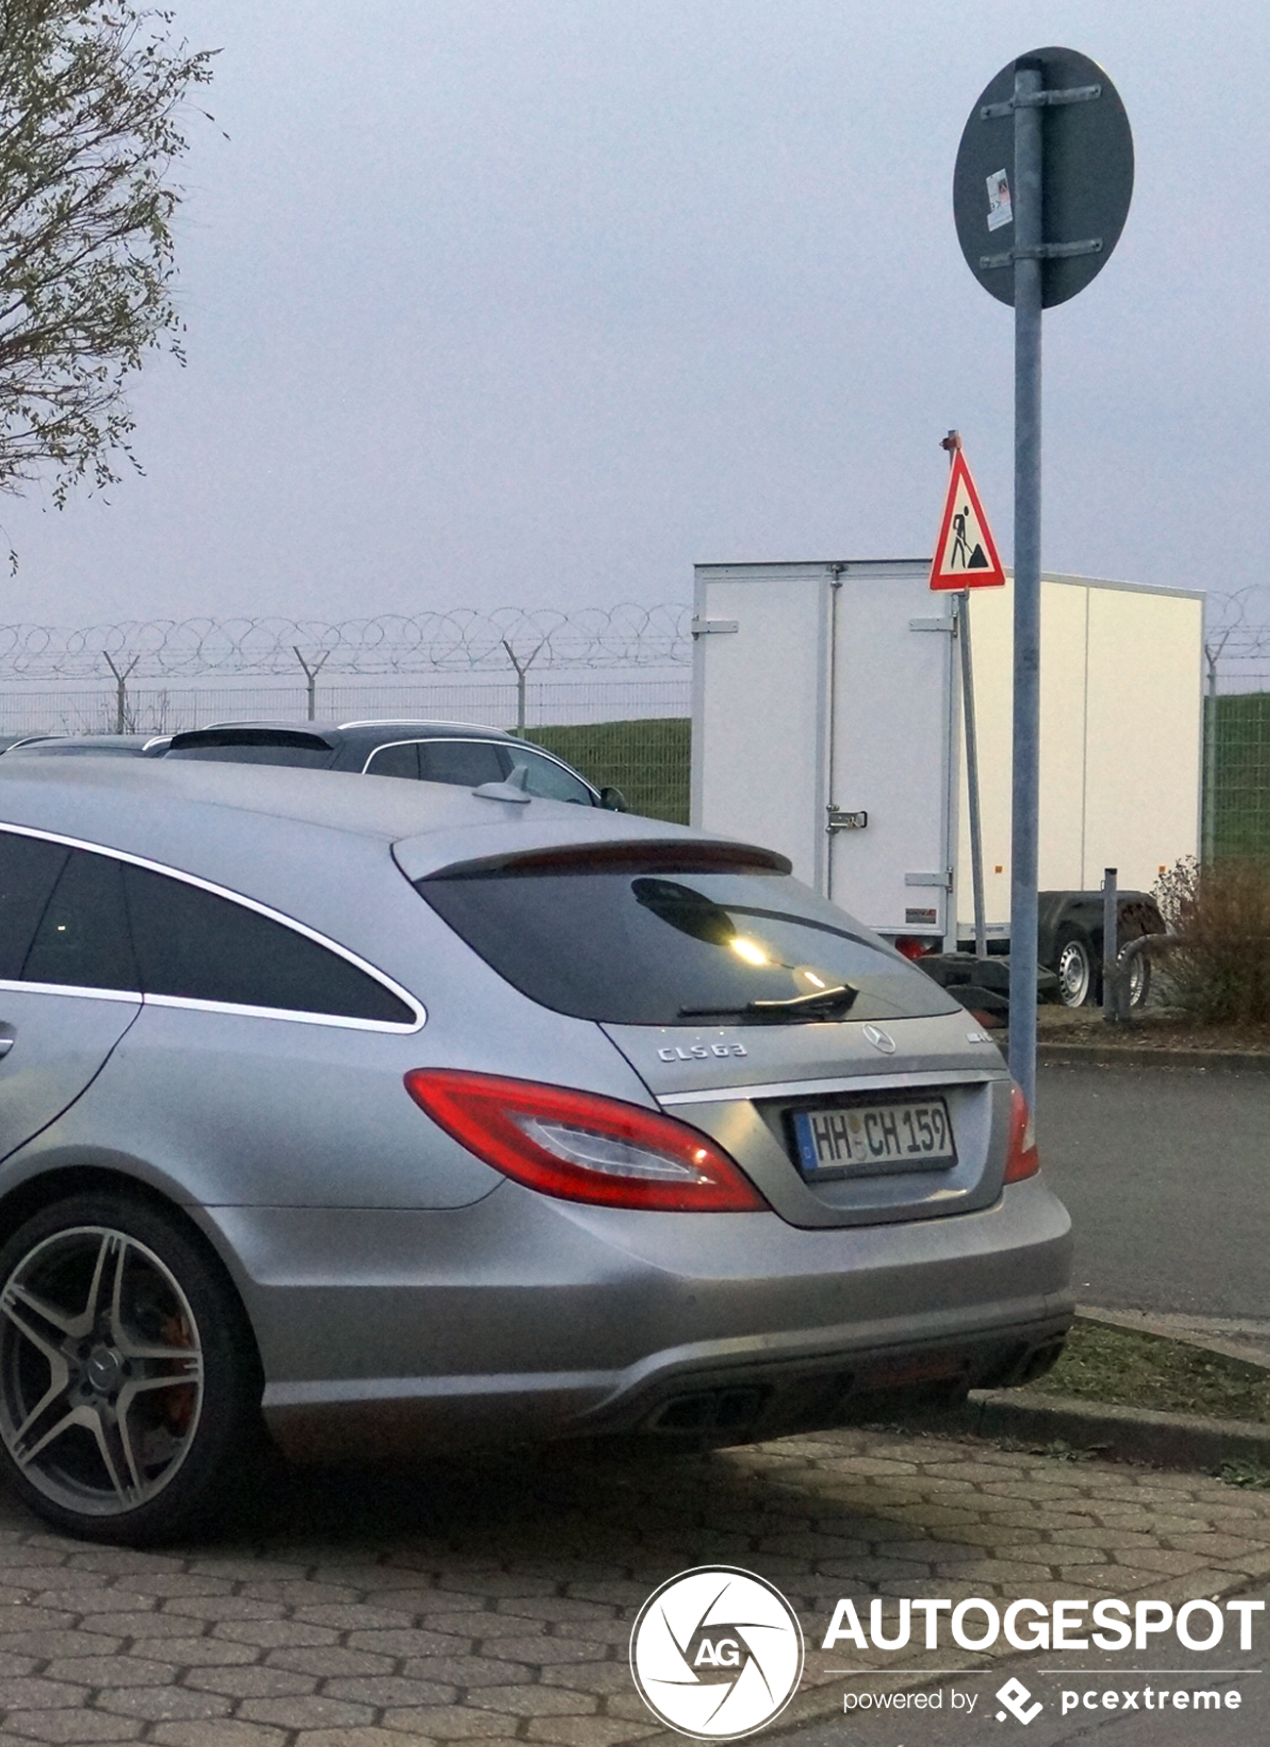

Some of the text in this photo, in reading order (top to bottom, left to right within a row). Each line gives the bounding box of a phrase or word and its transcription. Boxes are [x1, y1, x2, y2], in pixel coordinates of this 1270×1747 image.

[657, 1043, 748, 1063] CLS 63
[812, 1108, 946, 1161] HH CH 159
